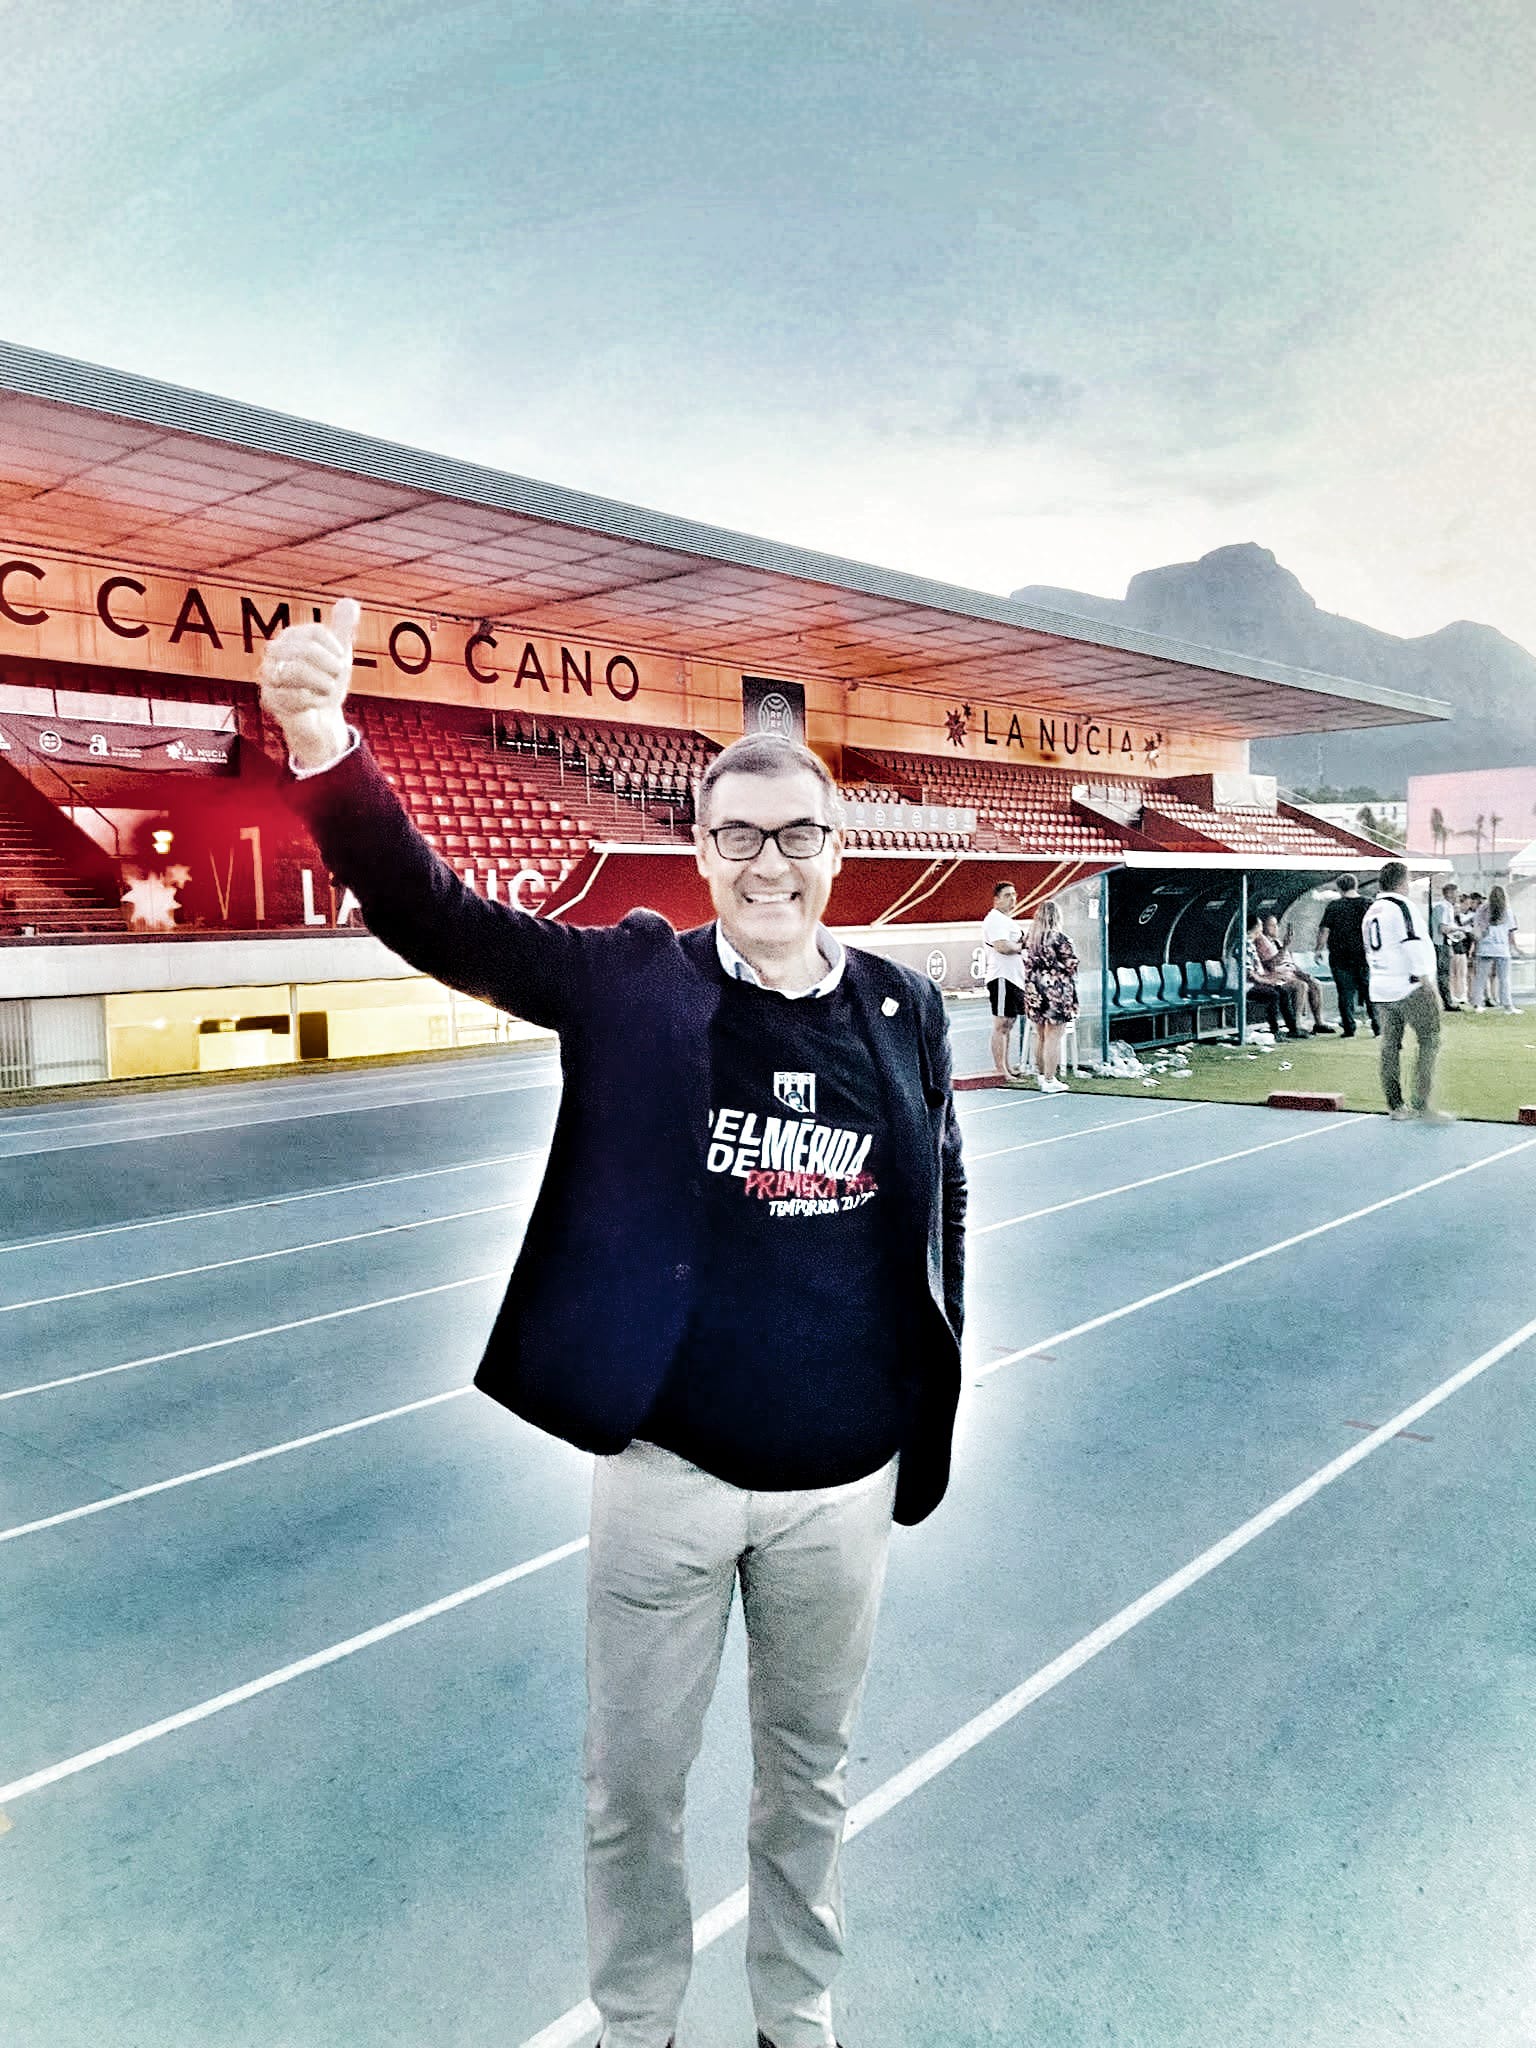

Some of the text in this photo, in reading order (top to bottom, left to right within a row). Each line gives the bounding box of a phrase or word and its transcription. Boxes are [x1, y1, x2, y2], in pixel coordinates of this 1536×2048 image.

[96, 575, 432, 676] CAMO
[465, 631, 640, 702] CANO
[983, 709, 1025, 749] LA
[708, 1108, 762, 1147] EL
[706, 1142, 762, 1179] DE
